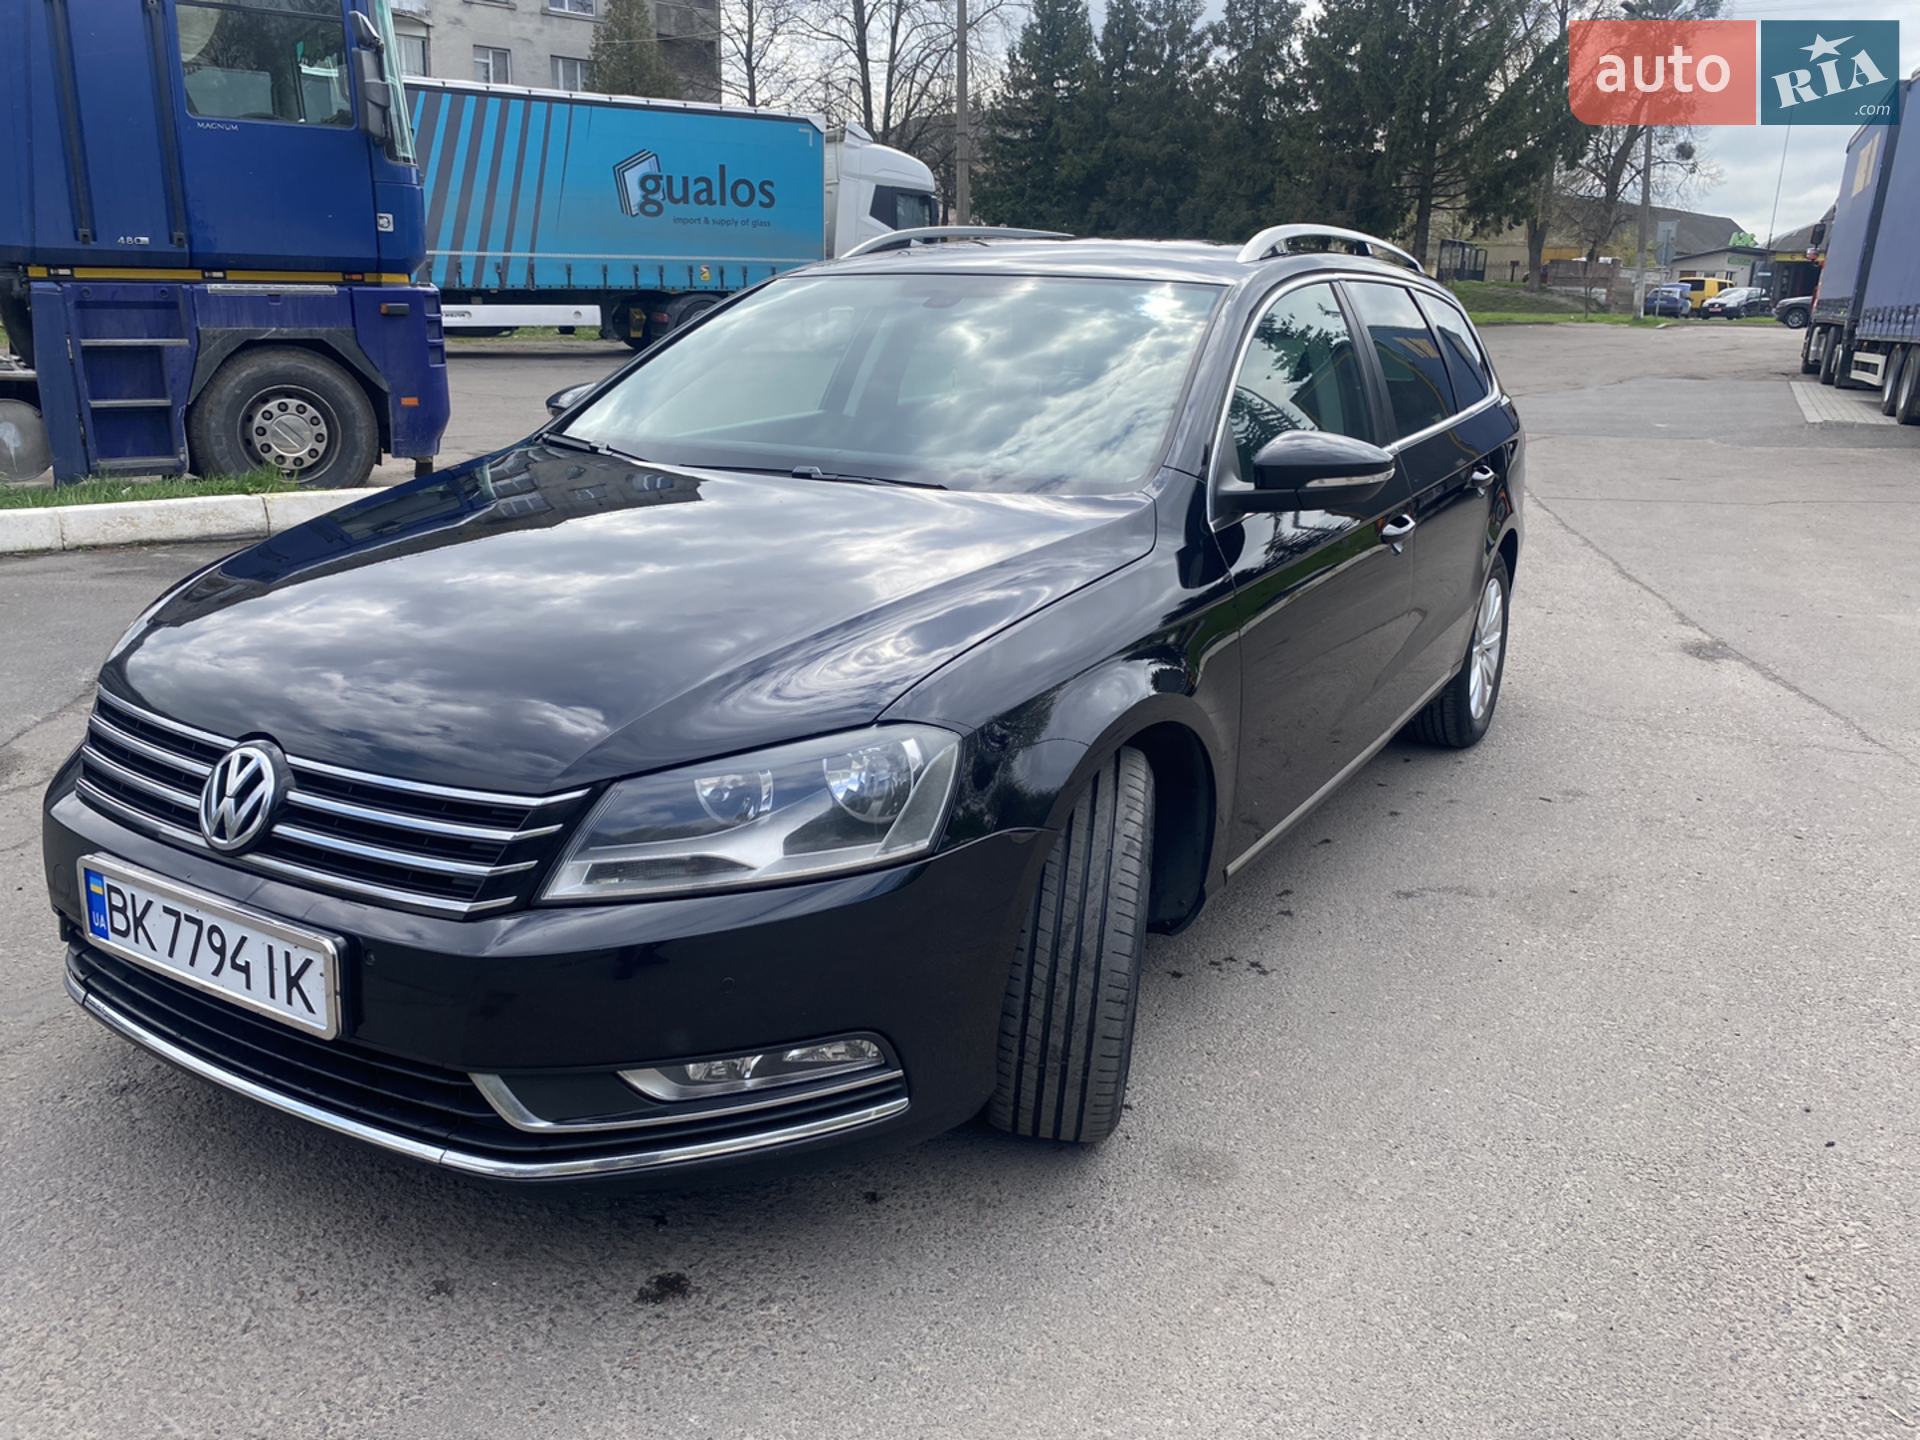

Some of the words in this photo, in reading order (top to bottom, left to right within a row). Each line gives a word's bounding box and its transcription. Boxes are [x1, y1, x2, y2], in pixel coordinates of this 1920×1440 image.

[196, 121, 240, 131] MAGNUM
[639, 164, 776, 218] gualos
[672, 215, 702, 226] import
[703, 216, 710, 225] &
[711, 217, 738, 228] supply
[740, 218, 749, 227] of
[751, 219, 771, 229] glass
[92, 911, 107, 931] UA
